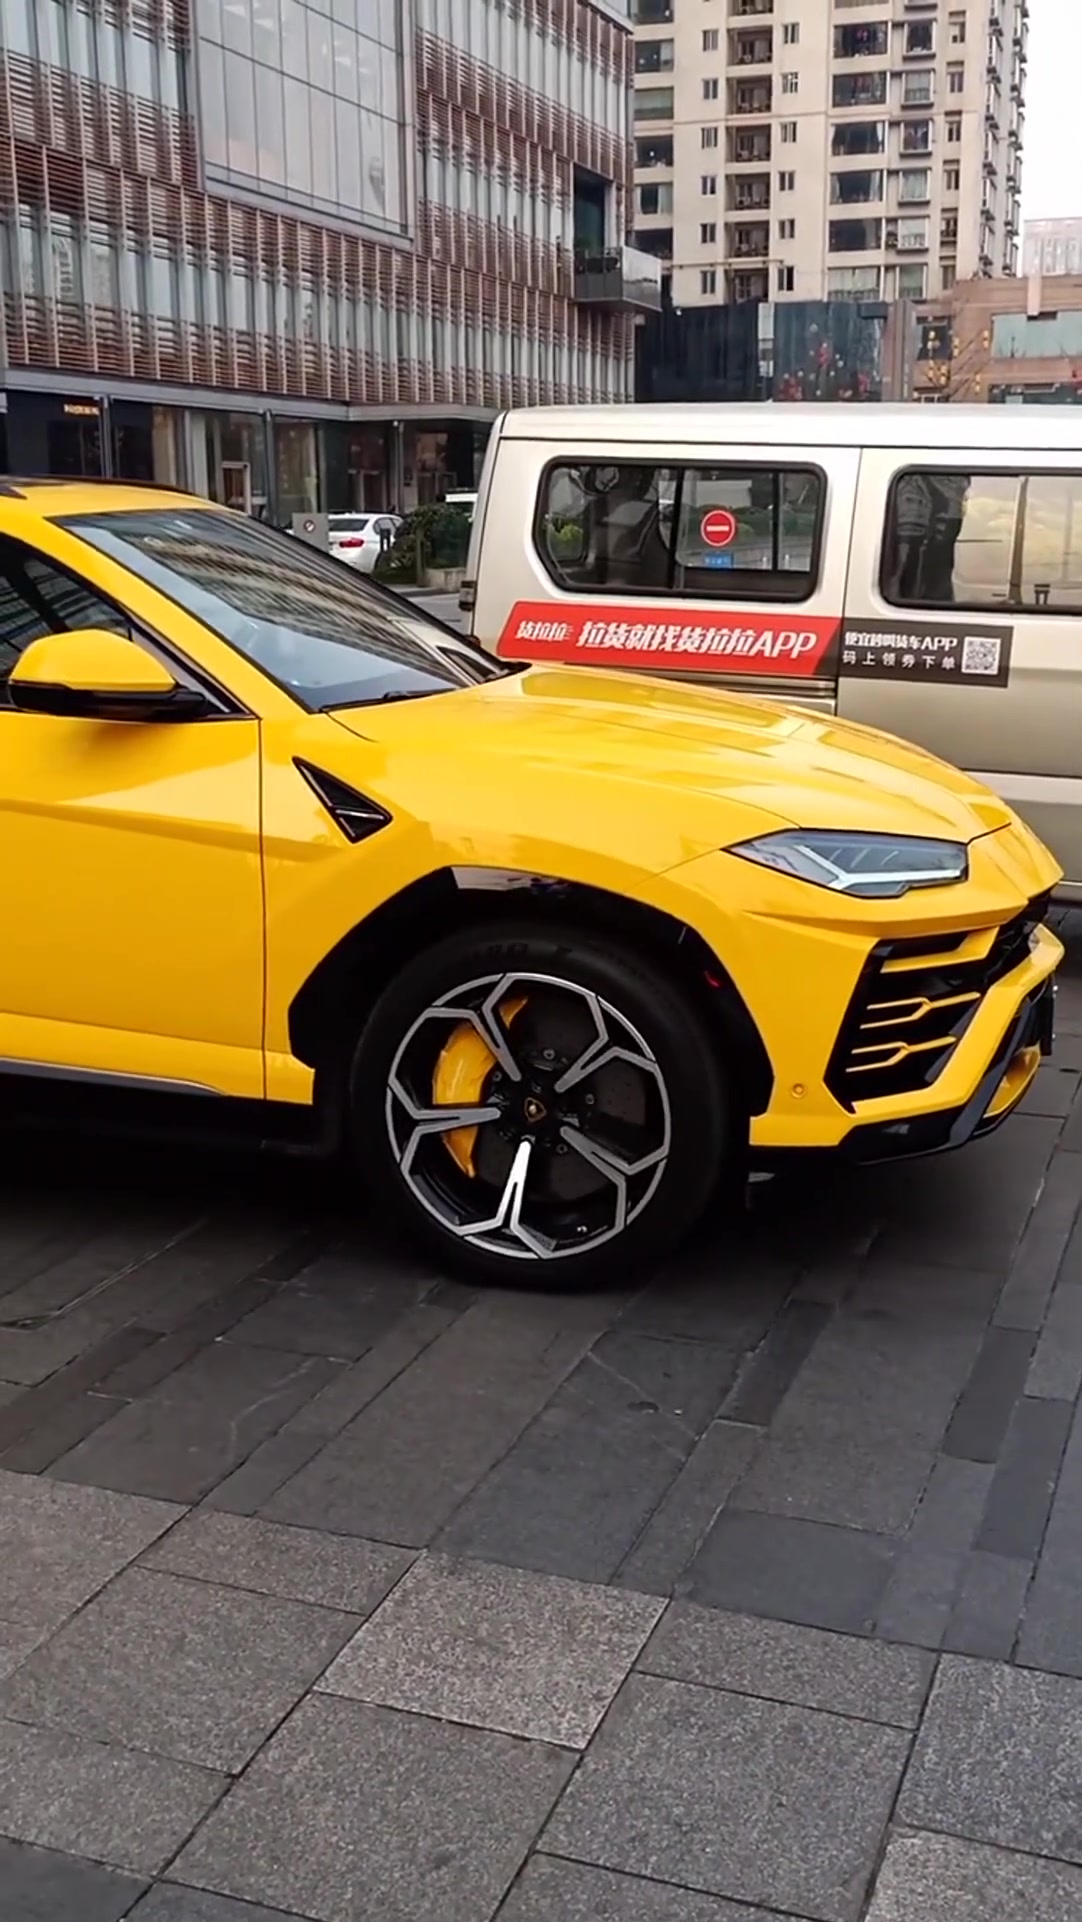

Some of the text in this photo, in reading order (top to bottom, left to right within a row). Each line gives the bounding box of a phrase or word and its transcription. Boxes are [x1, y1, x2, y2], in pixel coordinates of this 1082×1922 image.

[576, 621, 817, 659] 拉货就找货拉拉APP
